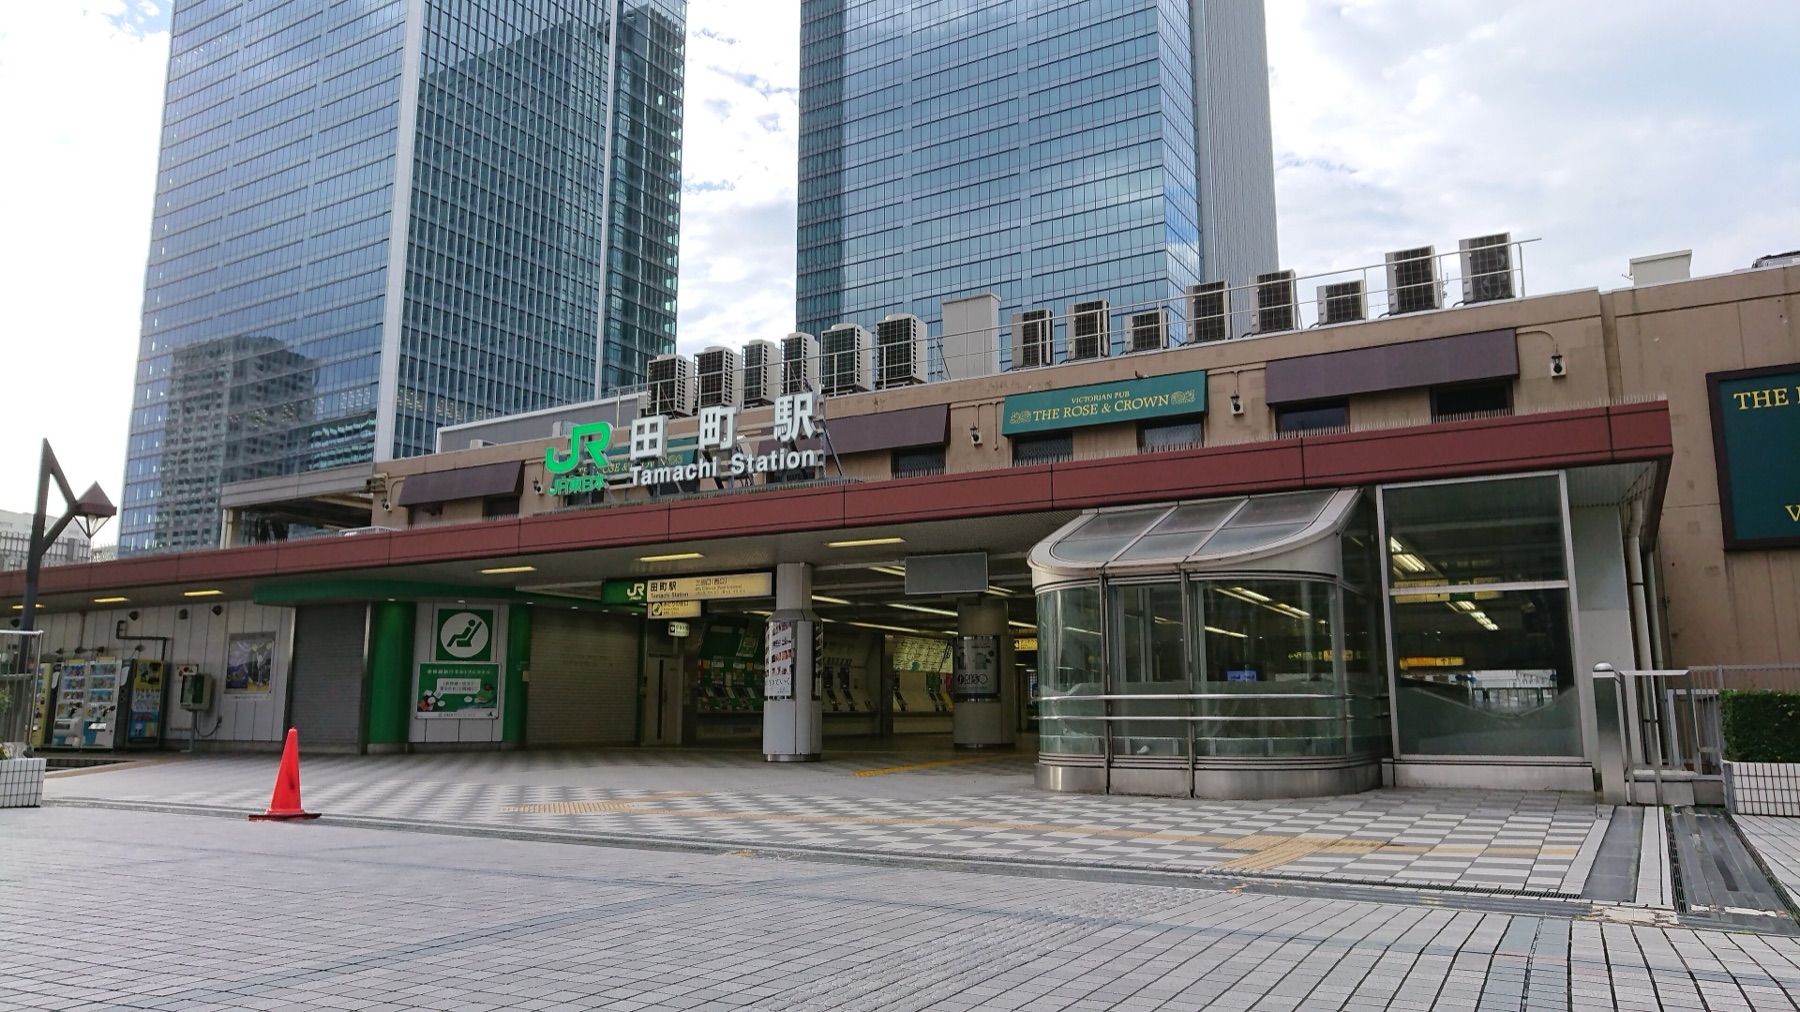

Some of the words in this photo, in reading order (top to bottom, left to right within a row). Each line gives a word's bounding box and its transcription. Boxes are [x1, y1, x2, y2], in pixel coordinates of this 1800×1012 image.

[1033, 409, 1060, 422] THE
[1063, 403, 1098, 418] ROSE
[1101, 403, 1111, 413] &
[1114, 394, 1169, 411] CROWN
[1071, 395, 1113, 404] VICTORIAN
[1114, 390, 1130, 399] PUB
[1733, 387, 1789, 410] THE
[630, 392, 816, 460] 田町駅
[546, 421, 610, 474] JR
[629, 456, 717, 487] Tamachi
[730, 447, 816, 475] Station
[547, 474, 606, 496] JR東日本
[626, 582, 645, 597] JR
[650, 581, 677, 592] 田町駅
